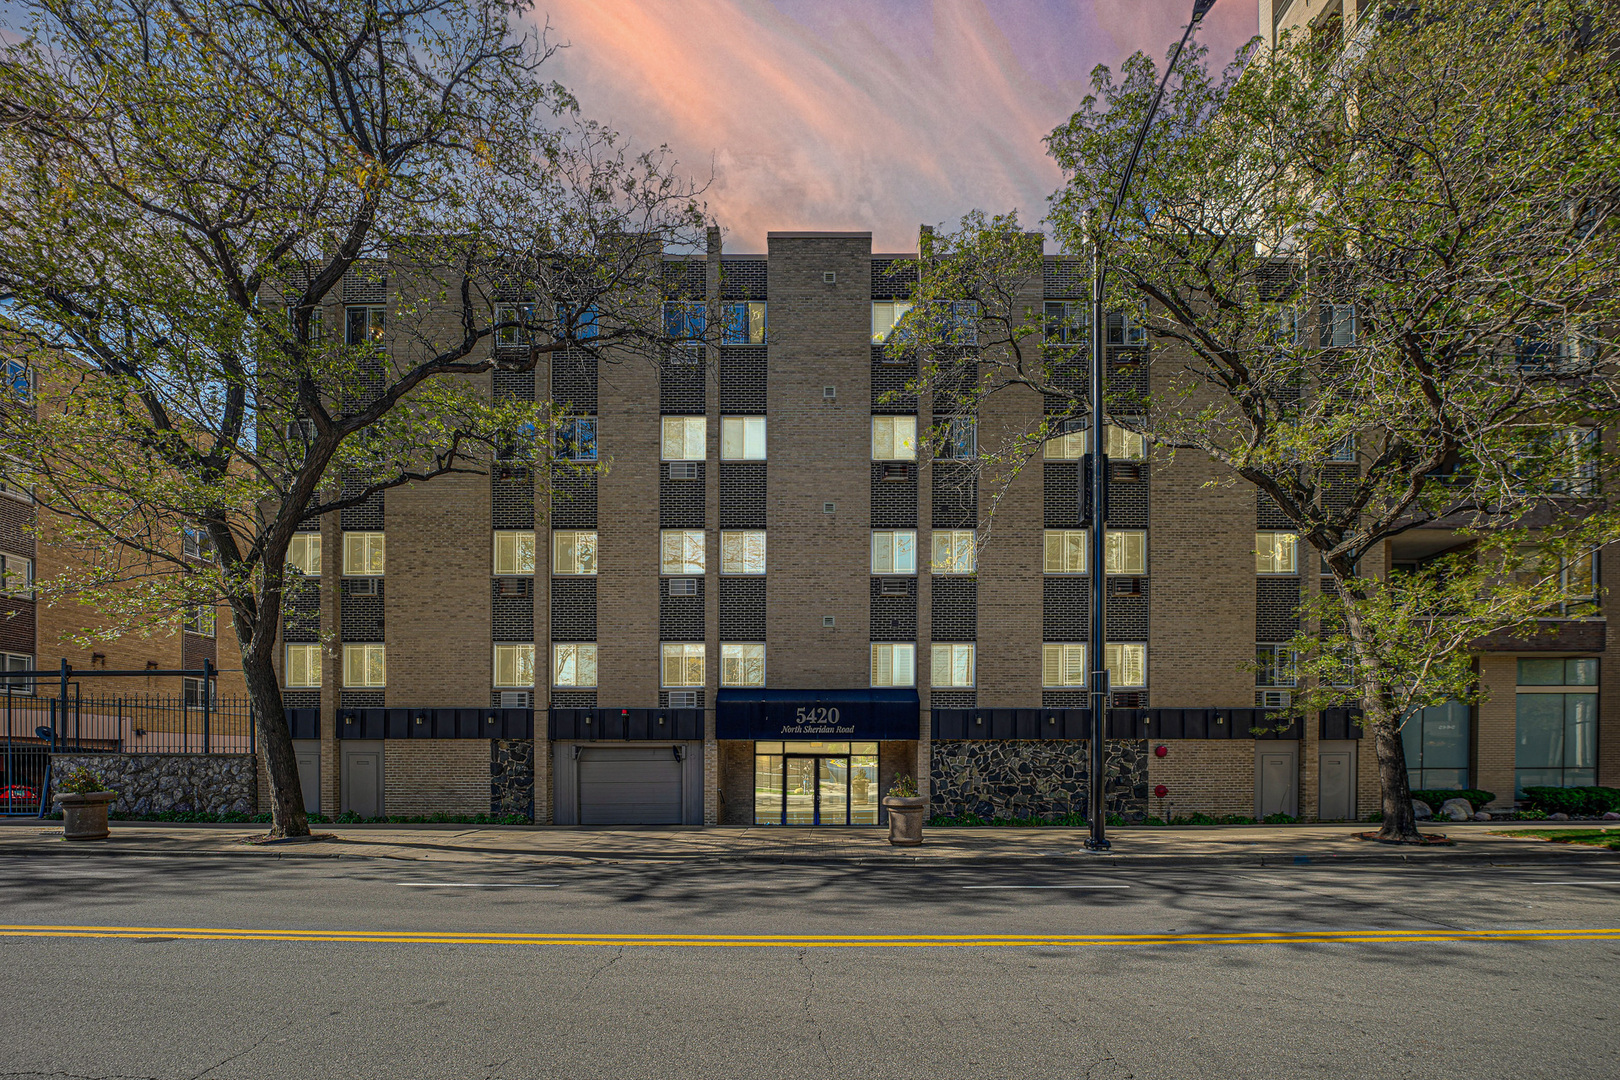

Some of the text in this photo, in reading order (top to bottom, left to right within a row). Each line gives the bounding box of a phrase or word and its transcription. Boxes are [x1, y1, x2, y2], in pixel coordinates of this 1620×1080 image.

[796, 707, 840, 724] 5420
[781, 725, 855, 734] North Sheridan Road
